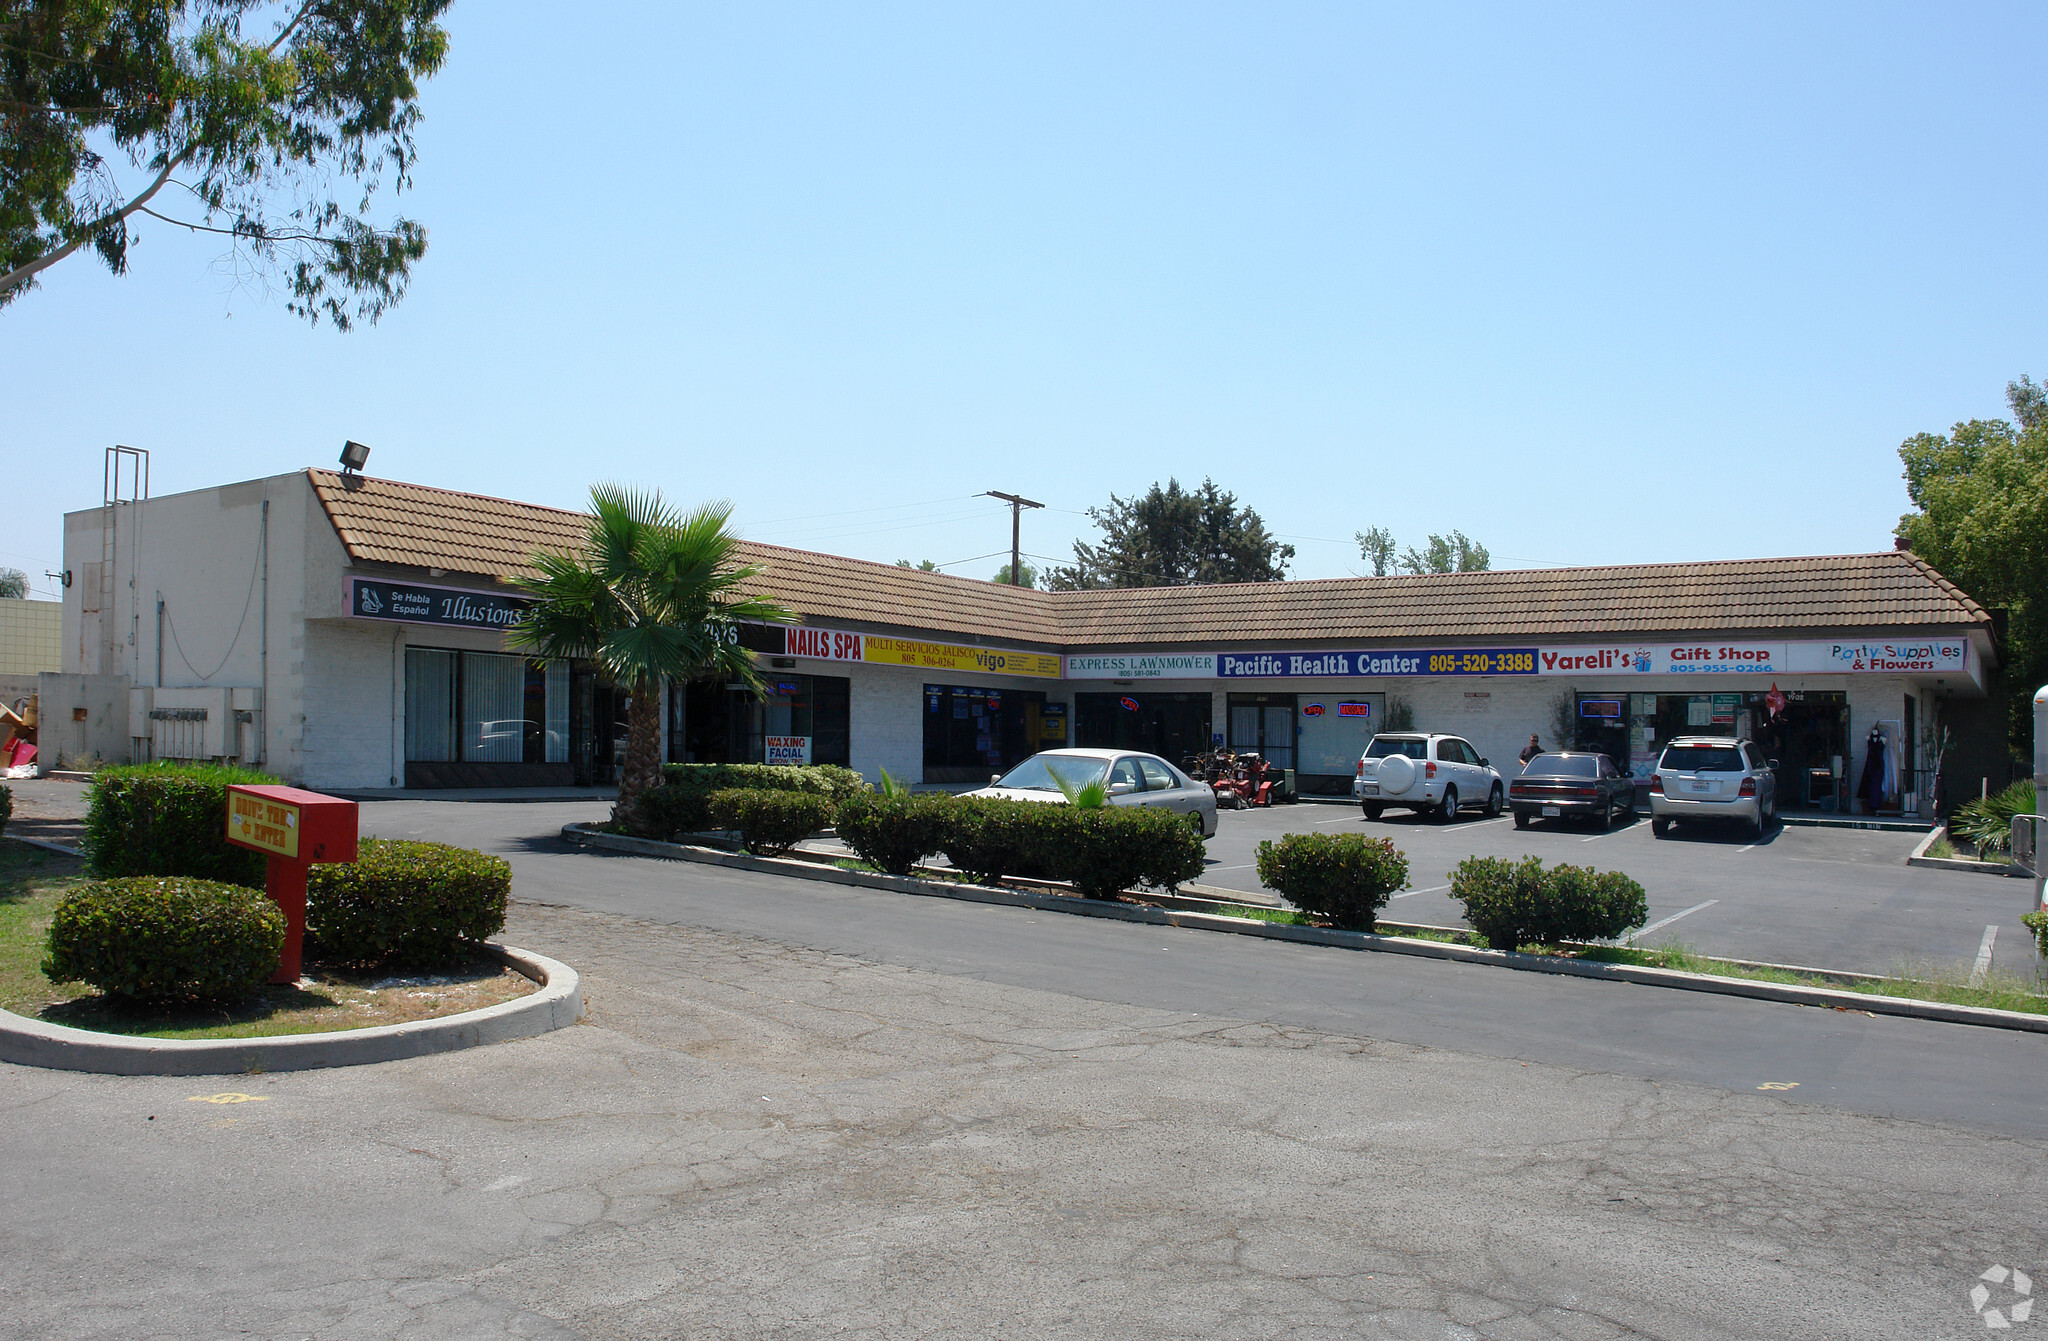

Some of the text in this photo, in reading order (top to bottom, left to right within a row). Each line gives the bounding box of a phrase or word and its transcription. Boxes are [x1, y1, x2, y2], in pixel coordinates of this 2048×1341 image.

[391, 591, 431, 604] Se Habla
[392, 603, 430, 616] Español
[441, 596, 523, 626] Illusions
[787, 628, 862, 660] NAILS SPA
[865, 637, 976, 659] MULTI SERVICIOS JALISCO
[1831, 642, 1961, 660] Party Supplies
[901, 652, 956, 668] 805 306-0264
[976, 650, 1006, 671] vigo
[1541, 649, 1630, 670] Yareli's
[1670, 647, 1770, 661] Gift Shop
[1070, 657, 1126, 670] EXPRESS
[1130, 655, 1212, 669] LAWNMOWER
[1224, 652, 1420, 675] Pacific Health Center
[1429, 653, 1533, 672] 805-520-3388
[1669, 664, 1773, 673] 805-955-0266
[1852, 658, 1934, 670] & Flowers
[1134, 669, 1161, 677] 581-0843
[1121, 697, 1138, 711] OPEN
[1303, 705, 1325, 716] OPEN
[1340, 705, 1368, 716] MASSAGE
[767, 737, 806, 748] WAXING
[769, 748, 804, 758] FACIAL
[236, 796, 263, 820] DRIVE
[254, 822, 286, 849] ENTER
